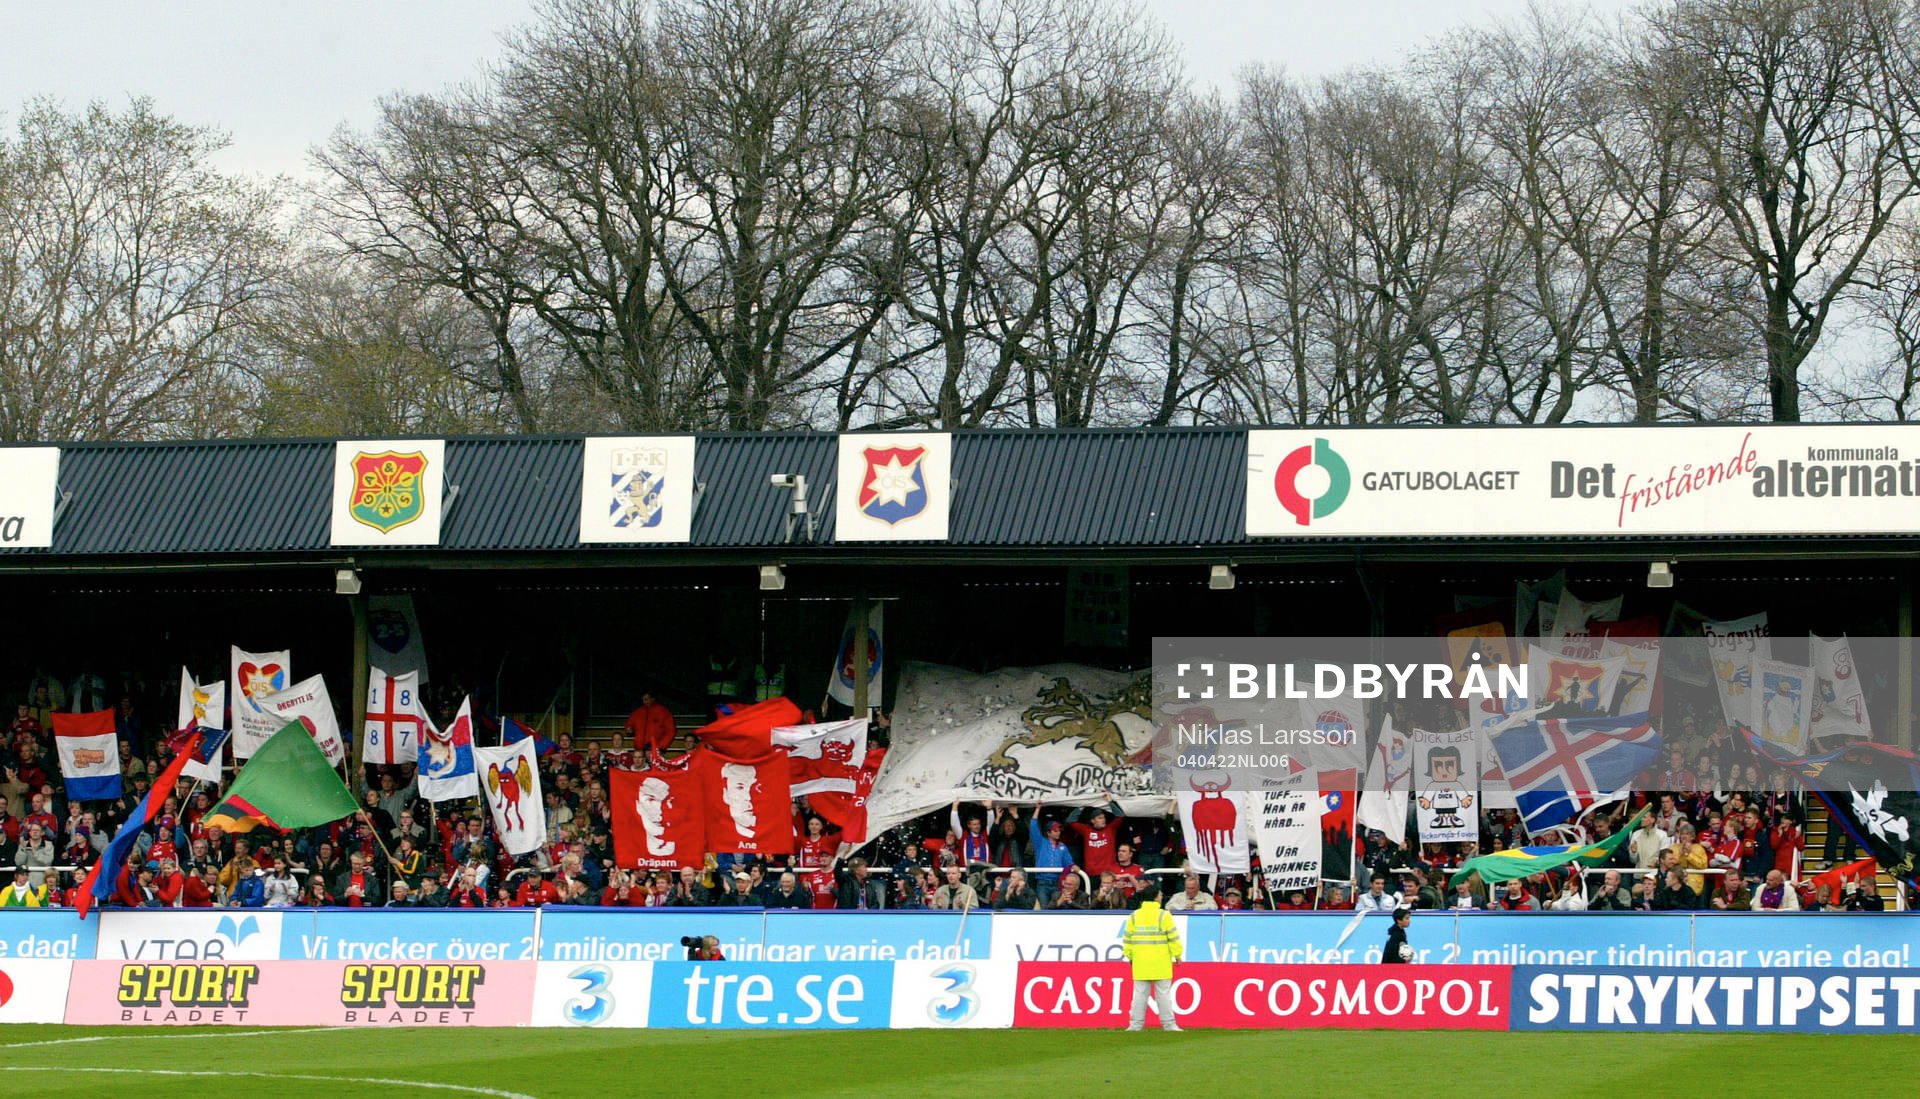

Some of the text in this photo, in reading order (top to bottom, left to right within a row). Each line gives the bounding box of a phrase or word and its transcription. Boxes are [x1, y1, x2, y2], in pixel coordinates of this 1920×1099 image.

[1807, 445, 1898, 461] kommunala
[1362, 471, 1520, 491] GATUBOLAGET
[1550, 461, 1616, 499] Det
[1618, 432, 1757, 528] fristående
[371, 688, 411, 706] 1 8
[370, 729, 410, 747] 8 7
[1414, 729, 1475, 744] Dick Last
[738, 841, 757, 850] Ane
[301, 934, 329, 960] Vi
[446, 937, 511, 960] över
[1208, 940, 1238, 962] Vi
[1363, 943, 1431, 964] öer
[1606, 943, 1748, 967] tidningar
[118, 964, 259, 1007] SPORT
[341, 964, 486, 1008] SPORT
[562, 963, 616, 1027] 3
[683, 964, 865, 1025] tre.se
[926, 961, 982, 1026] 3
[1023, 975, 1500, 1017] CASIO COSMOPOL
[1529, 973, 1920, 1027] STRYKTIPSET
[121, 1010, 248, 1022] BLADET
[344, 1010, 476, 1023] BLADET
